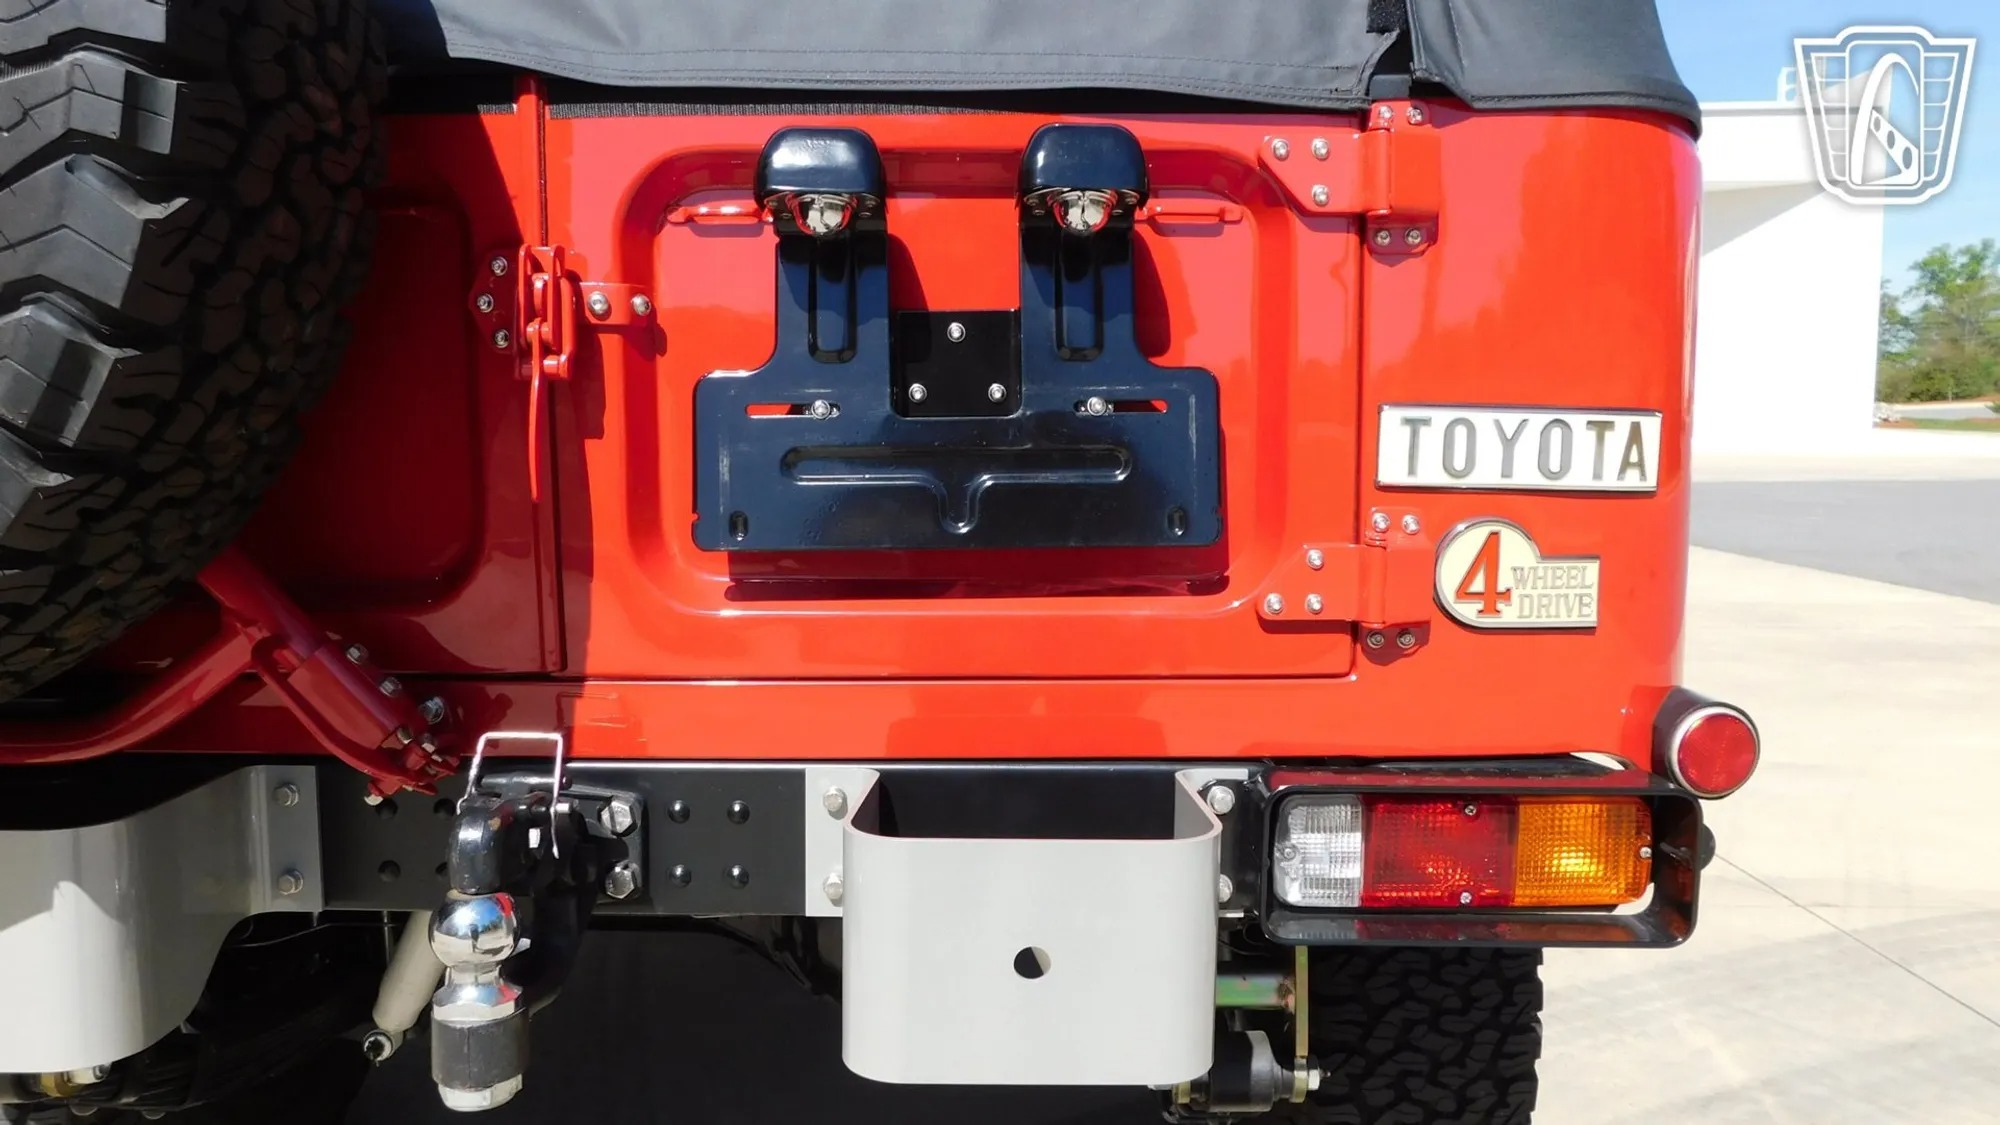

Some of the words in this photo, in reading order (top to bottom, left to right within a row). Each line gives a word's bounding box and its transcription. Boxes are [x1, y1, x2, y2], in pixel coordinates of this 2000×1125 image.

[1400, 417, 1647, 481] TOYOTA
[1454, 531, 1512, 618] 4
[1512, 565, 1594, 590] WHEEL
[1517, 593, 1594, 619] DRIVE
